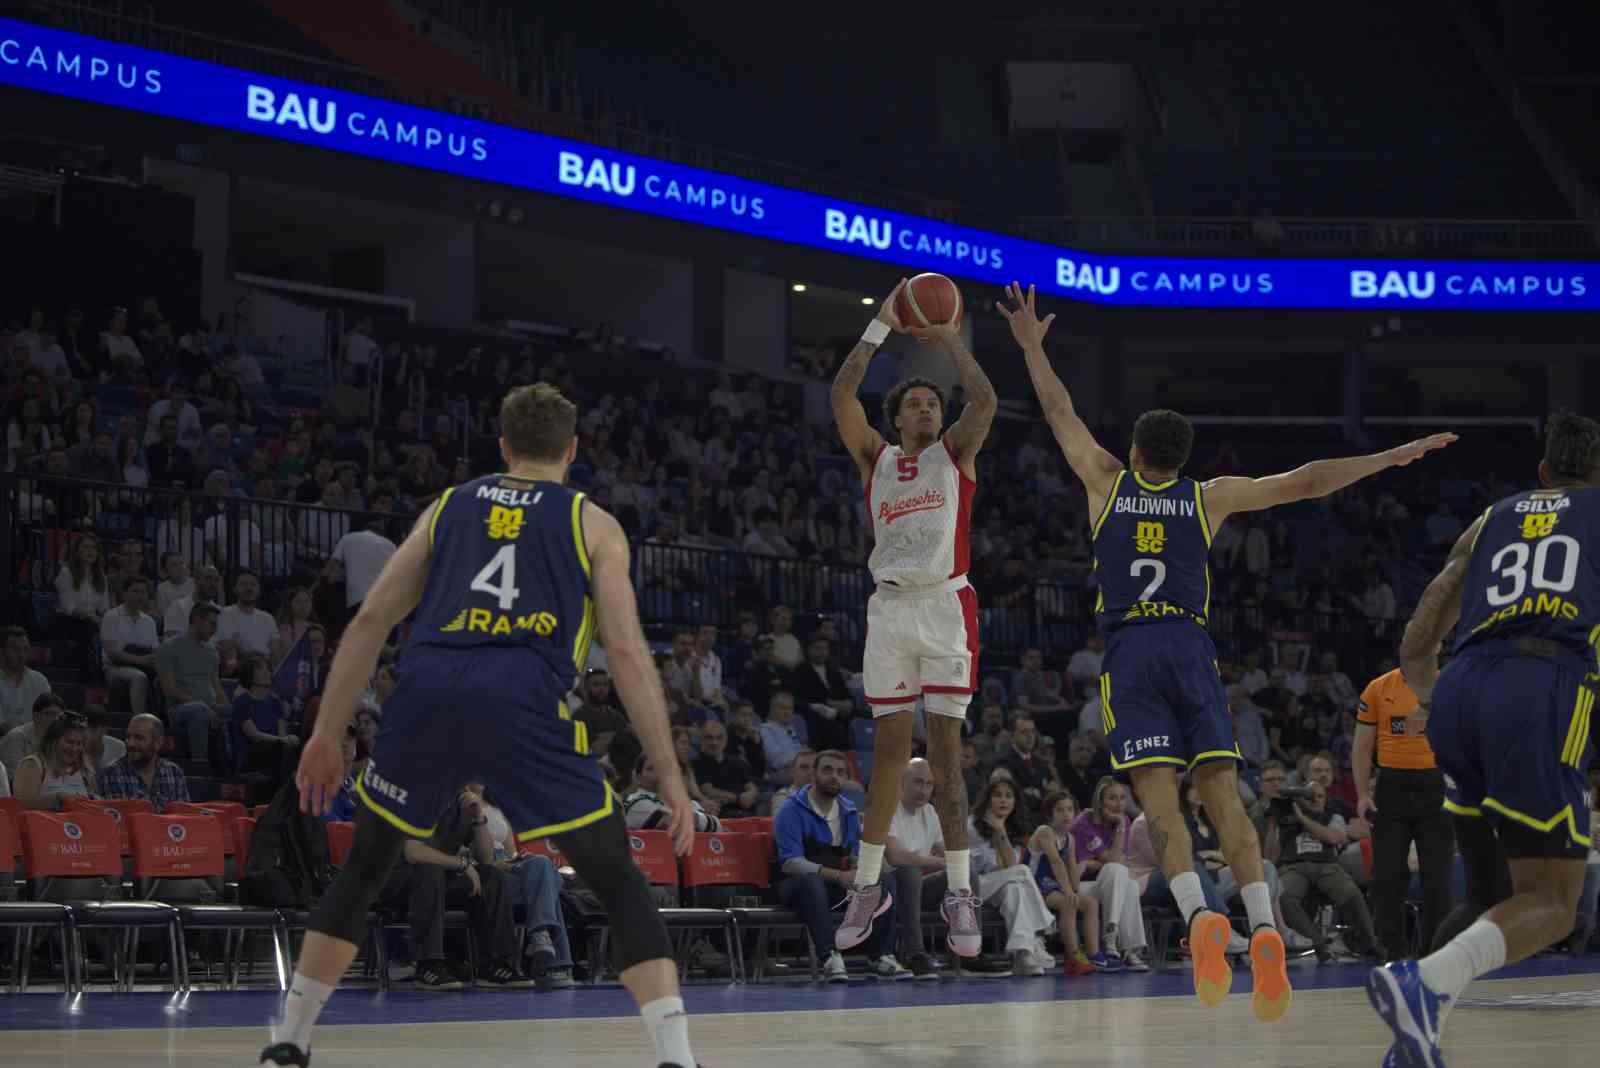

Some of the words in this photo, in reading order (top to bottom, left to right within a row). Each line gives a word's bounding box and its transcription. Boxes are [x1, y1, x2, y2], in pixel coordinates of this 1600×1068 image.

[0, 39, 163, 94] CAMPUS
[246, 84, 337, 134] BAU
[347, 111, 489, 161] CAMPUS
[558, 150, 636, 197] BAU
[643, 175, 766, 220] CAMPUS
[824, 208, 892, 250] BAU
[898, 229, 1005, 270] CAMPUS
[1056, 257, 1120, 295] BAU
[1130, 271, 1275, 294] CAMPUS
[1350, 270, 1435, 299] BAU
[1445, 275, 1587, 297] CAMPUS
[896, 455, 919, 482] 5
[475, 484, 544, 506] MELLI
[1114, 496, 1177, 516] BALDWIN
[1180, 500, 1195, 517] IV
[1514, 495, 1571, 513] SILVA
[470, 543, 520, 610] 4
[1129, 558, 1167, 602] 2
[1486, 534, 1581, 606] 30
[467, 607, 558, 637] RAMS
[1135, 735, 1170, 752] ENEZ
[371, 772, 409, 805] ENEZ
